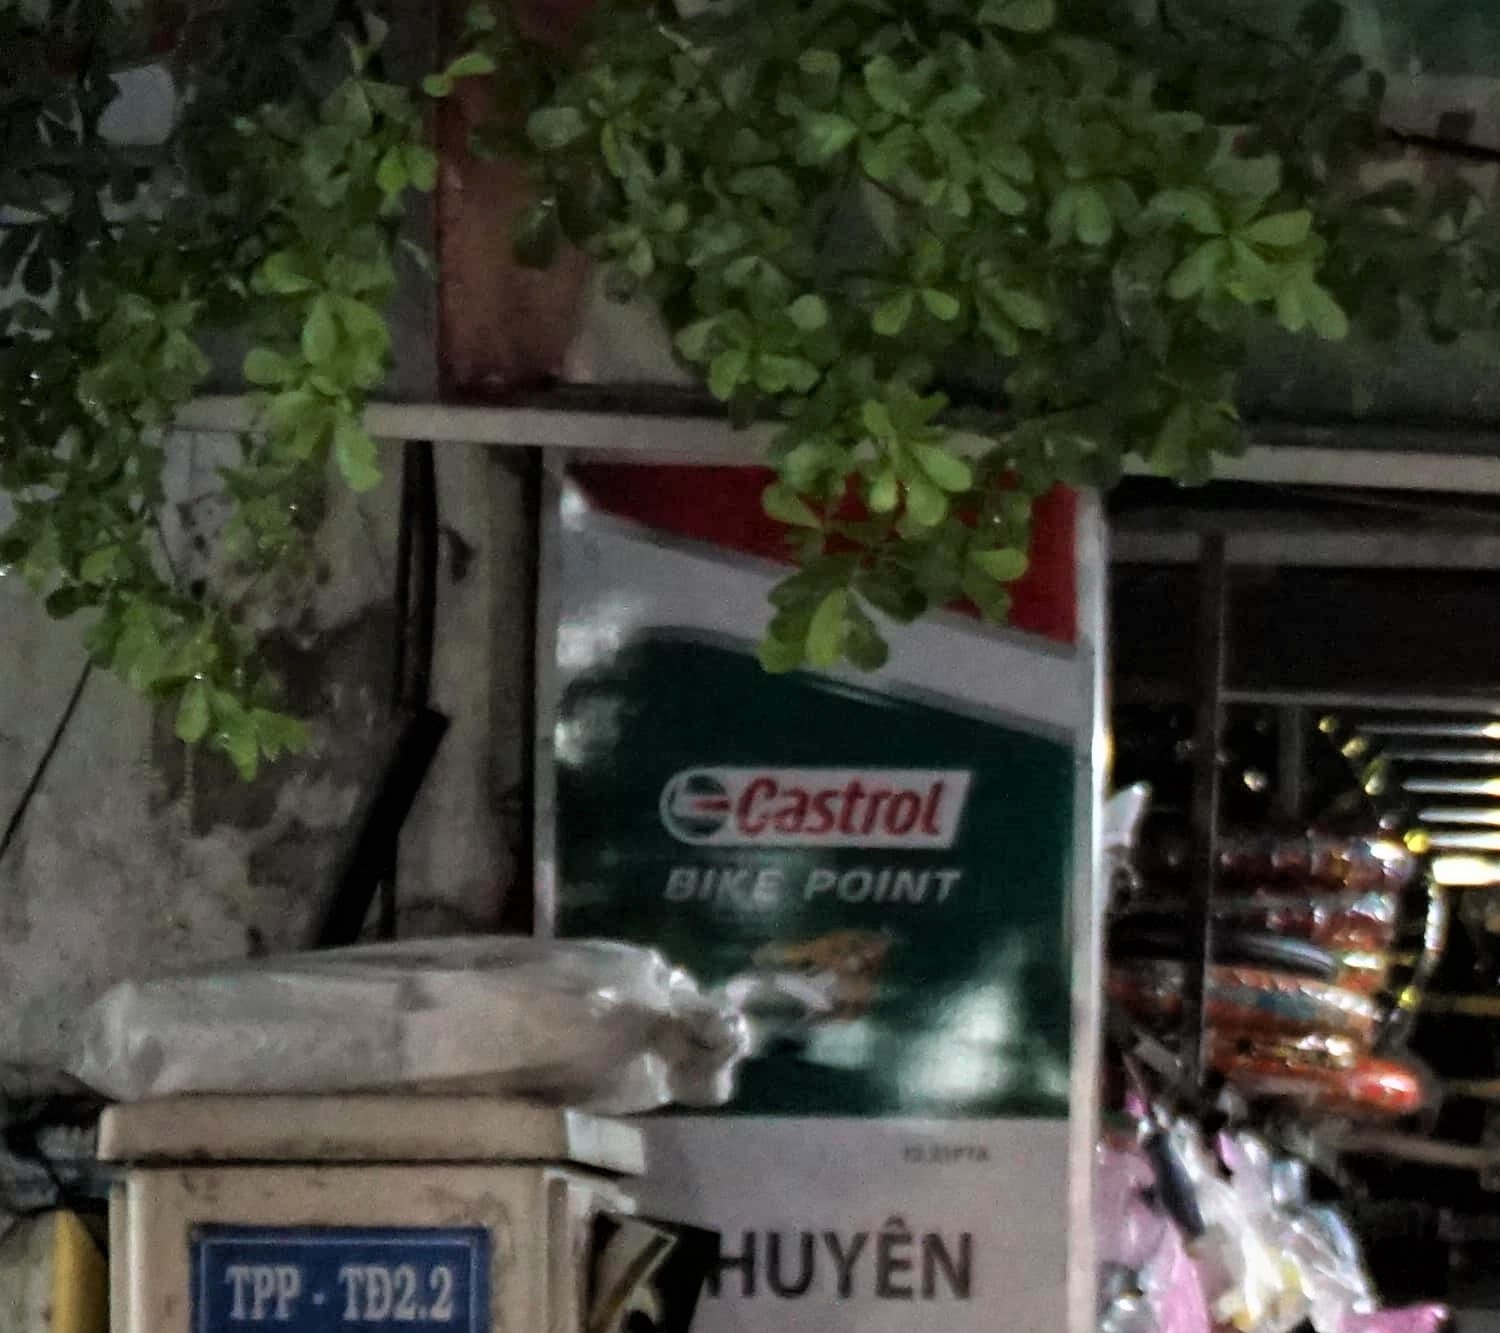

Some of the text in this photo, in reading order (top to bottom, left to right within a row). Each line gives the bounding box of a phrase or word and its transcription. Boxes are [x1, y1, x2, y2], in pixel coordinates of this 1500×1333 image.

[736, 776, 943, 838] Castrol
[664, 867, 965, 904] BIKE POINT
[702, 1214, 973, 1300] HUYÊN
[225, 1265, 302, 1321] TPP
